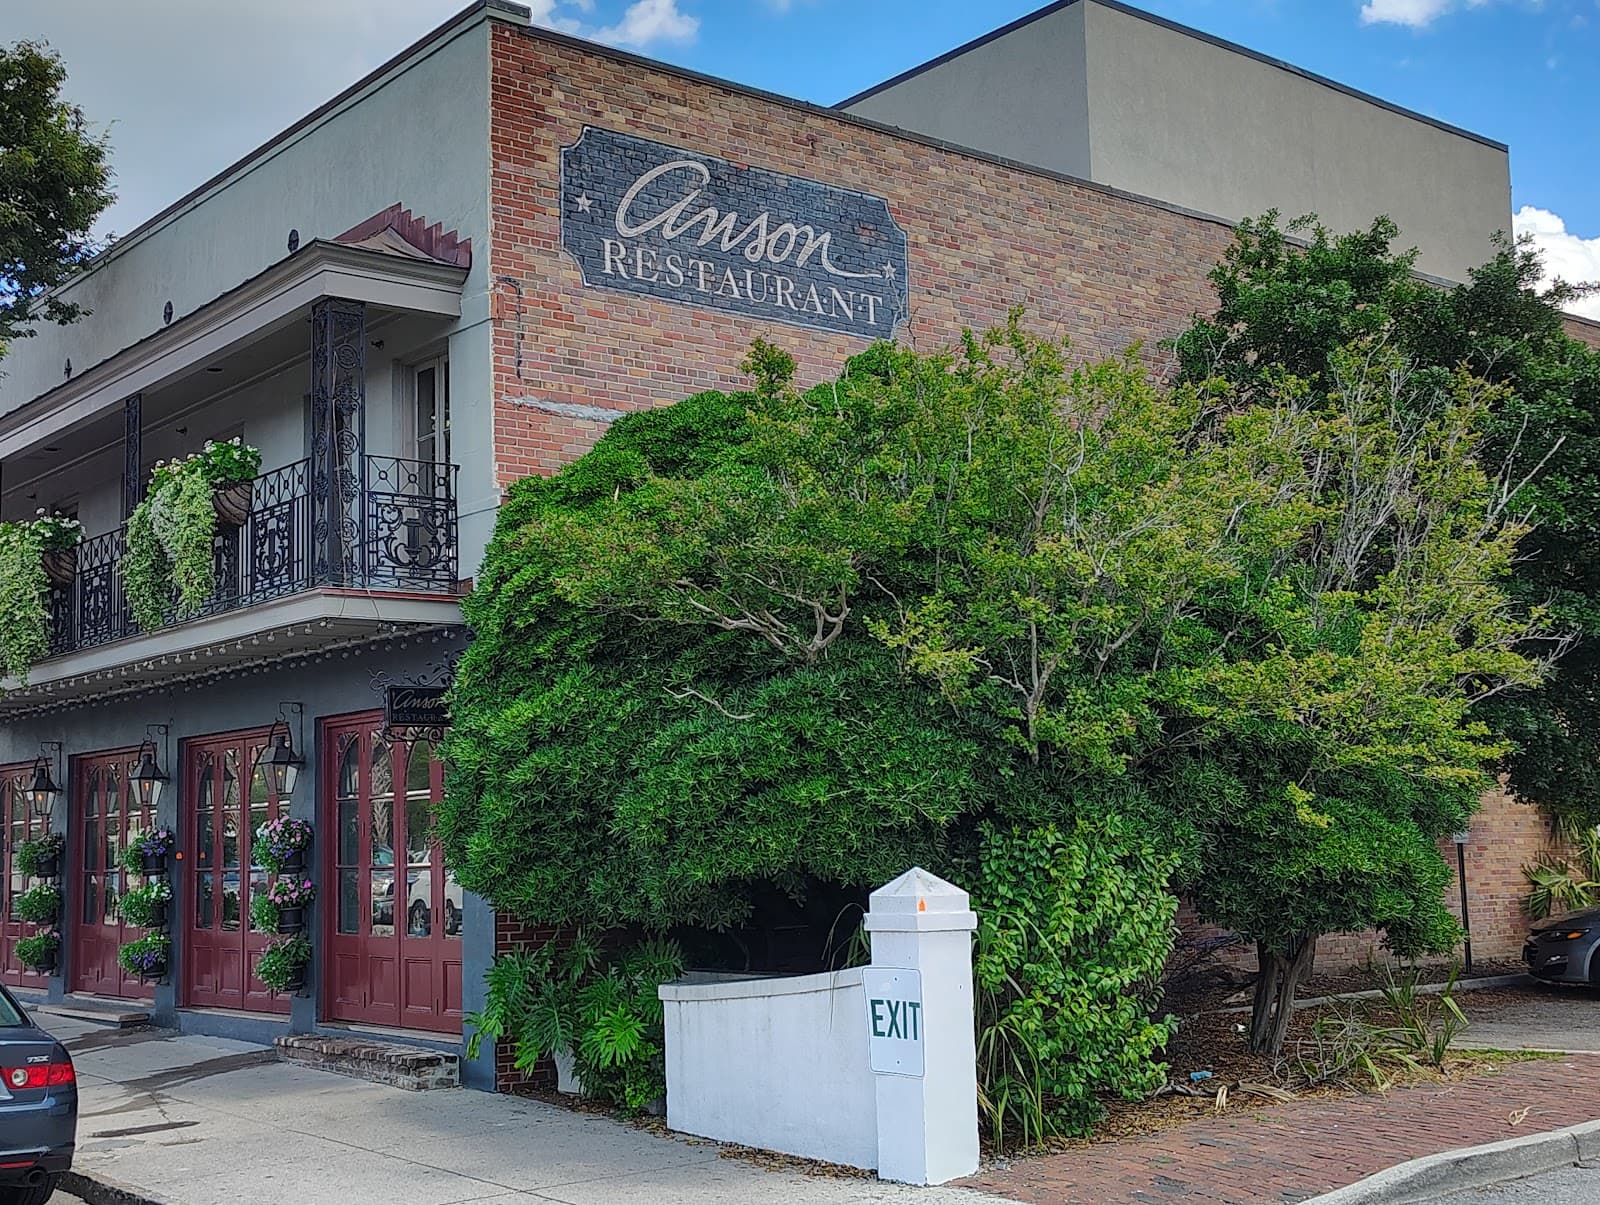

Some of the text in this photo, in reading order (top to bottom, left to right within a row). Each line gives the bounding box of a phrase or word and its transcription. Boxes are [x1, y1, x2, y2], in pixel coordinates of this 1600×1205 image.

[615, 160, 884, 279] Anson
[870, 999, 921, 1041] EXIT
[26, 1055, 50, 1063] TSX
